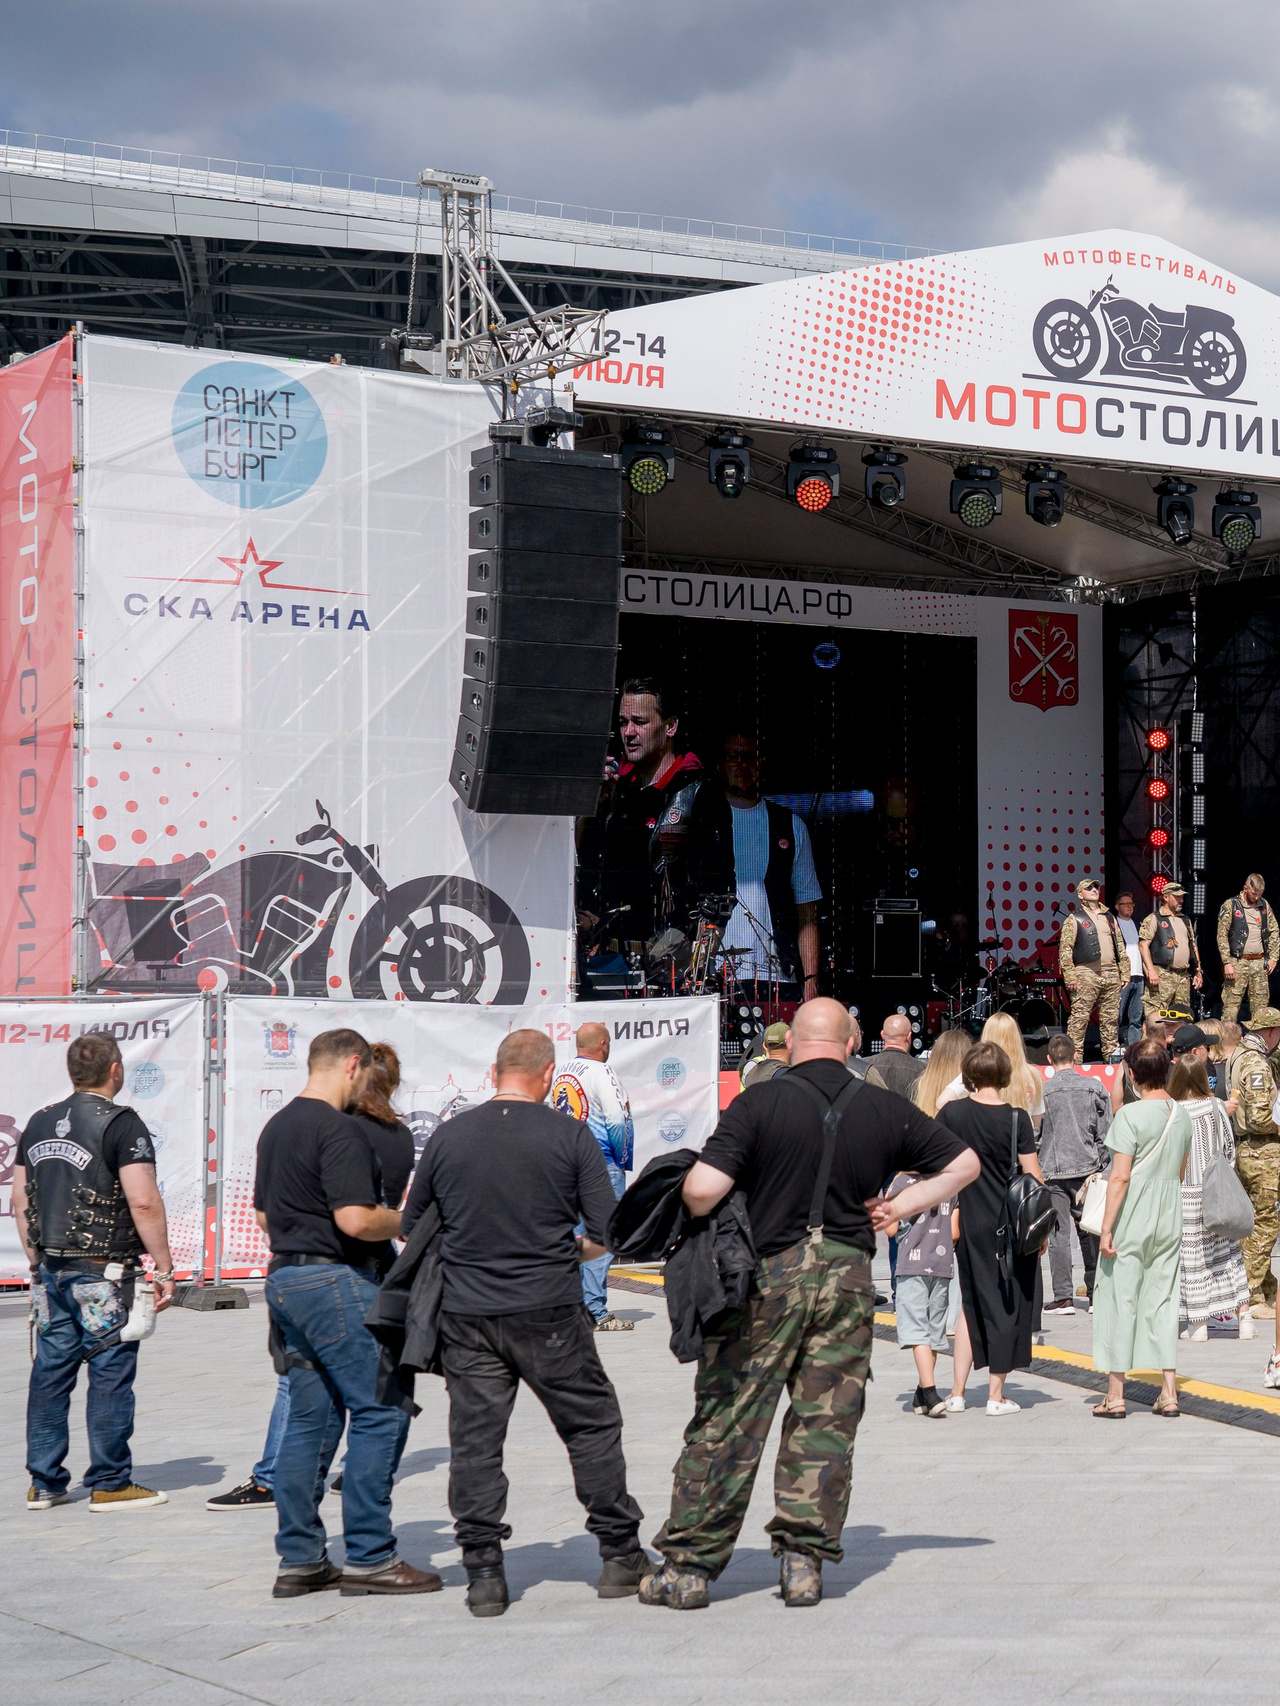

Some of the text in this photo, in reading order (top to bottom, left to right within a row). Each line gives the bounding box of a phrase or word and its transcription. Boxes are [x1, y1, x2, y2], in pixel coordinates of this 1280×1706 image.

[1043, 249, 1237, 295] МОТОФЕСТИВАЛЬ
[591, 327, 667, 359] 12-14
[572, 356, 665, 389] ИЮЛЯ
[203, 384, 296, 419] САНКТ
[204, 416, 297, 451] ПЕТЕР
[204, 449, 278, 482] БУРГ
[123, 592, 371, 632] СКА АРЕНА
[624, 574, 853, 620] СТОЛИЦА.РФ
[614, 1017, 690, 1041] ИЮЛЯ
[661, 1063, 681, 1071] САНКТ
[1251, 1074, 1263, 1086] Z
